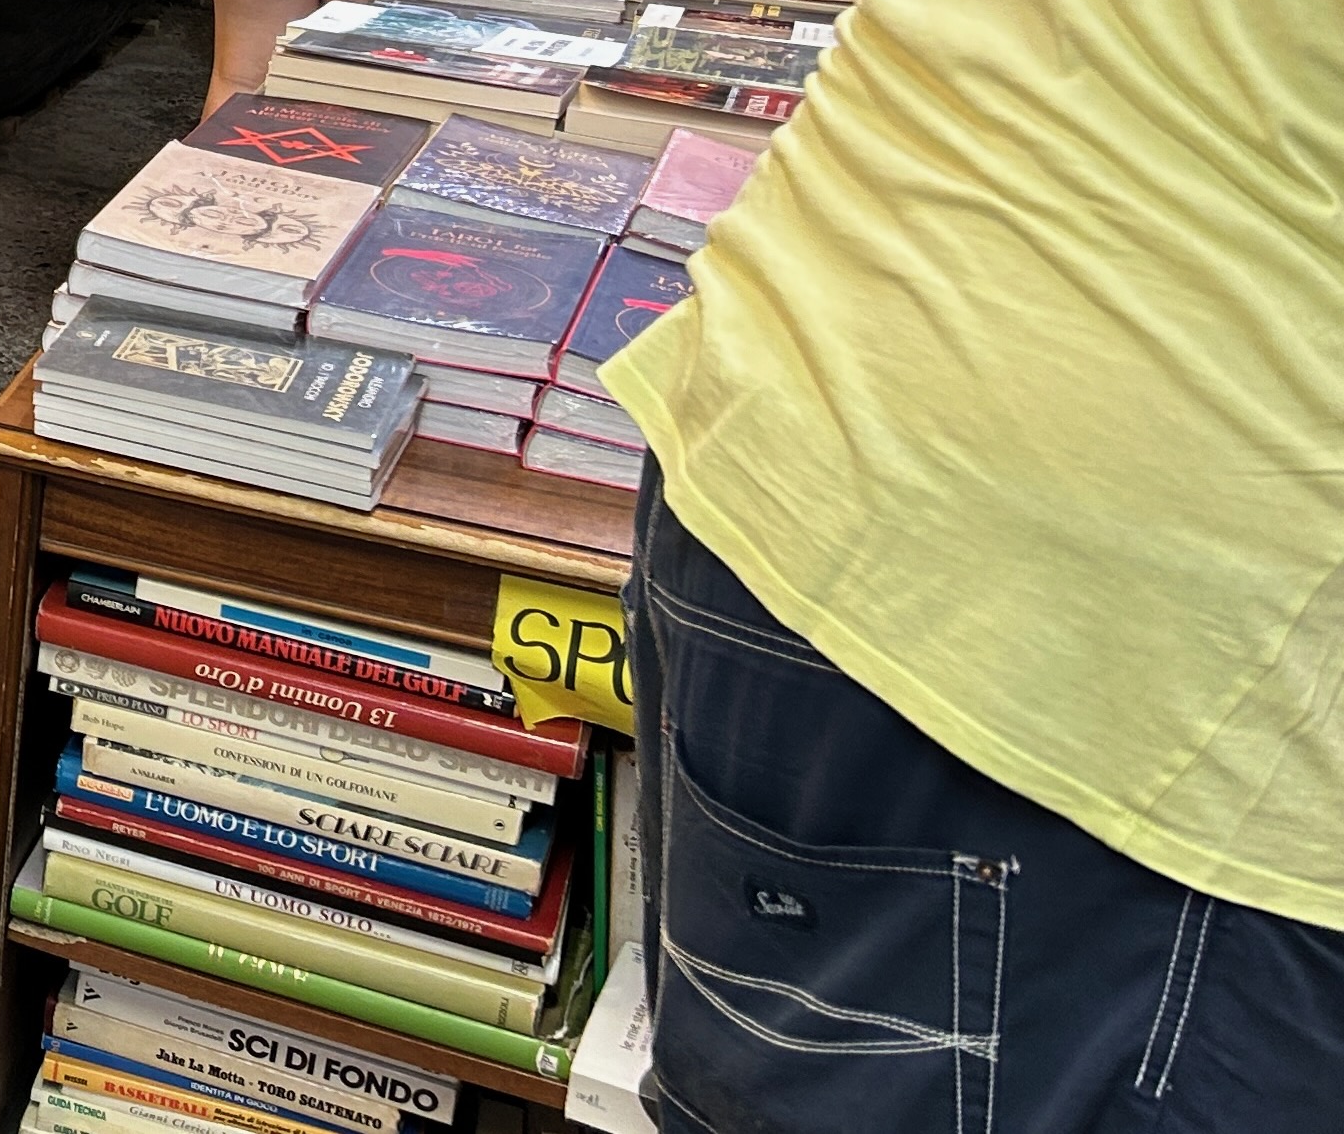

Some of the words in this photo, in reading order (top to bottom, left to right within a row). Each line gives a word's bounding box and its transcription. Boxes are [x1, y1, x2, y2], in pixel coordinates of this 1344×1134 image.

[322, 351, 375, 423] JODOROWSKY
[80, 592, 142, 616] CHAMBERLAIN
[154, 604, 235, 644] NUOVO
[237, 622, 352, 674] MANUALE
[356, 650, 401, 685] DEL
[403, 662, 467, 704] GOLF
[317, 631, 353, 647] canoa
[195, 663, 263, 695] d'Oro
[270, 681, 363, 723] Uomini
[80, 684, 94, 698] IN
[95, 686, 129, 708] PRIMO
[130, 694, 167, 716] PIANO
[180, 710, 204, 729] LO
[207, 715, 262, 742] SPORT
[148, 675, 319, 738] SPLENDORI
[319, 718, 430, 764] DELLO
[431, 742, 555, 793] SPORT
[369, 708, 398, 730] 13
[81, 712, 100, 726] Bob
[101, 717, 126, 733] Hope
[213, 745, 286, 775] CONFESSIONI
[288, 764, 304, 778] DI
[306, 769, 324, 783] UN
[326, 774, 399, 805] GOLFOMANE
[145, 790, 239, 840] L'UOMO
[242, 815, 259, 840] E
[263, 819, 298, 850] LO
[301, 829, 385, 872] SPORT
[297, 808, 402, 850] SCIARE
[403, 837, 510, 880] SCIARE
[111, 821, 147, 840] REYER
[256, 863, 278, 876] 100
[279, 868, 305, 884] ANNI
[308, 875, 321, 888] DI
[324, 879, 361, 900] SPORT
[376, 894, 423, 917] VENEZIA
[425, 907, 484, 933] 1872/1972
[214, 879, 246, 900] UN
[249, 887, 313, 919] UOMO
[91, 889, 173, 927] GOLF
[156, 1048, 187, 1066] Jake
[189, 1058, 206, 1073] La
[208, 1064, 245, 1086] Motta
[257, 1079, 295, 1101] TORO
[299, 1090, 383, 1130] SCATENATO
[227, 1029, 277, 1063] SCI
[285, 1049, 316, 1075] DI
[323, 1060, 439, 1113] FONDO
[47, 1095, 72, 1110] GUIDA
[72, 1101, 106, 1121] TECNICA
[104, 1081, 208, 1118] BASKETBALL
[129, 1105, 169, 1120] Gianni
[235, 1092, 246, 1103] IN
[248, 1096, 278, 1113] GIOCO
